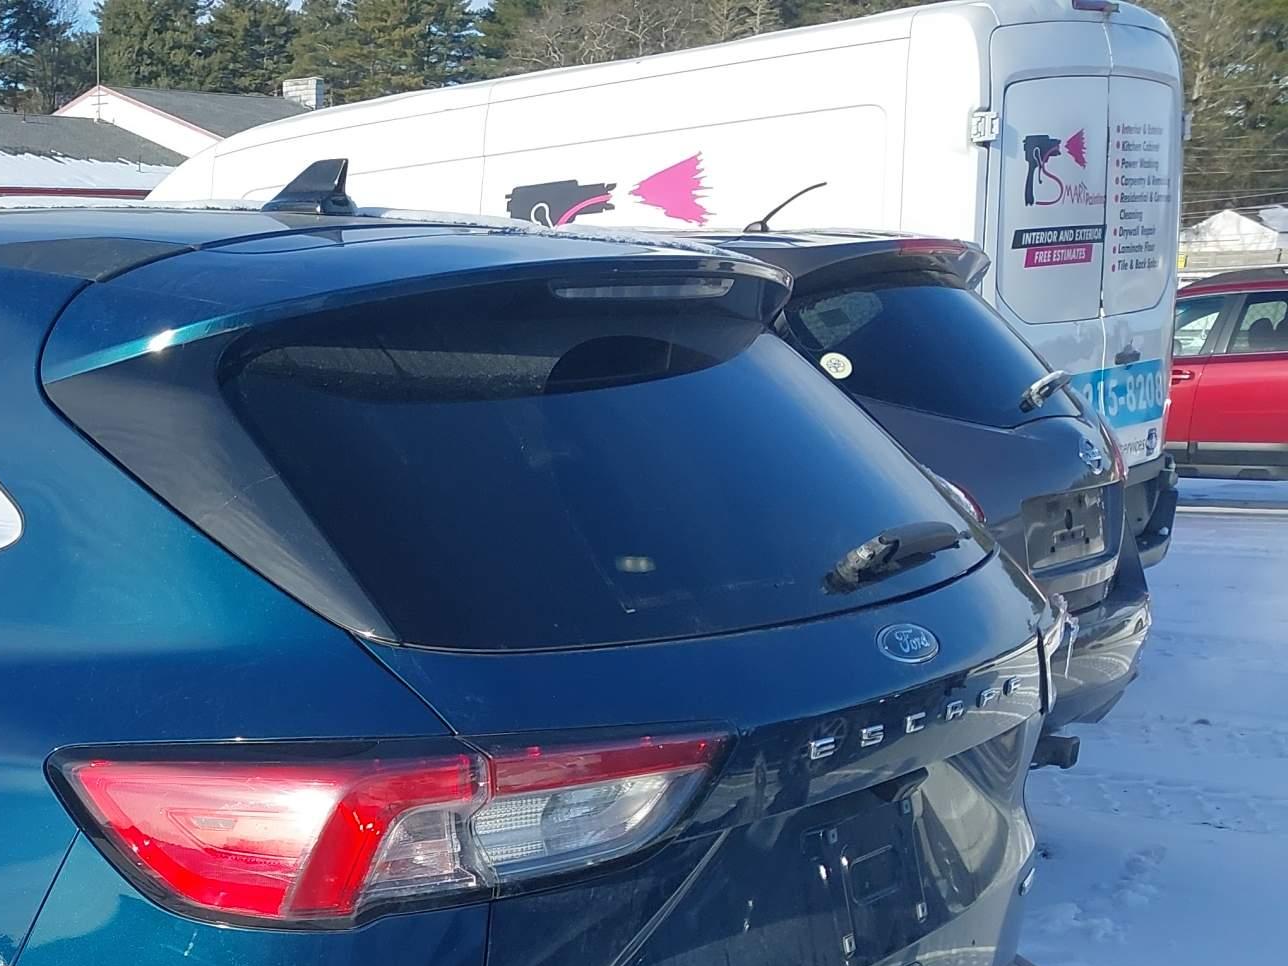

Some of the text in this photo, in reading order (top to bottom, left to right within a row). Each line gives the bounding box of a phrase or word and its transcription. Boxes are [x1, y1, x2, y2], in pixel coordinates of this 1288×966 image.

[1022, 228, 1102, 245] INTERIOR AND EXTERIOR
[1034, 248, 1086, 264] FREE ESTIMATES
[894, 629, 930, 653] Ford
[809, 675, 1021, 761] ESCAPE
